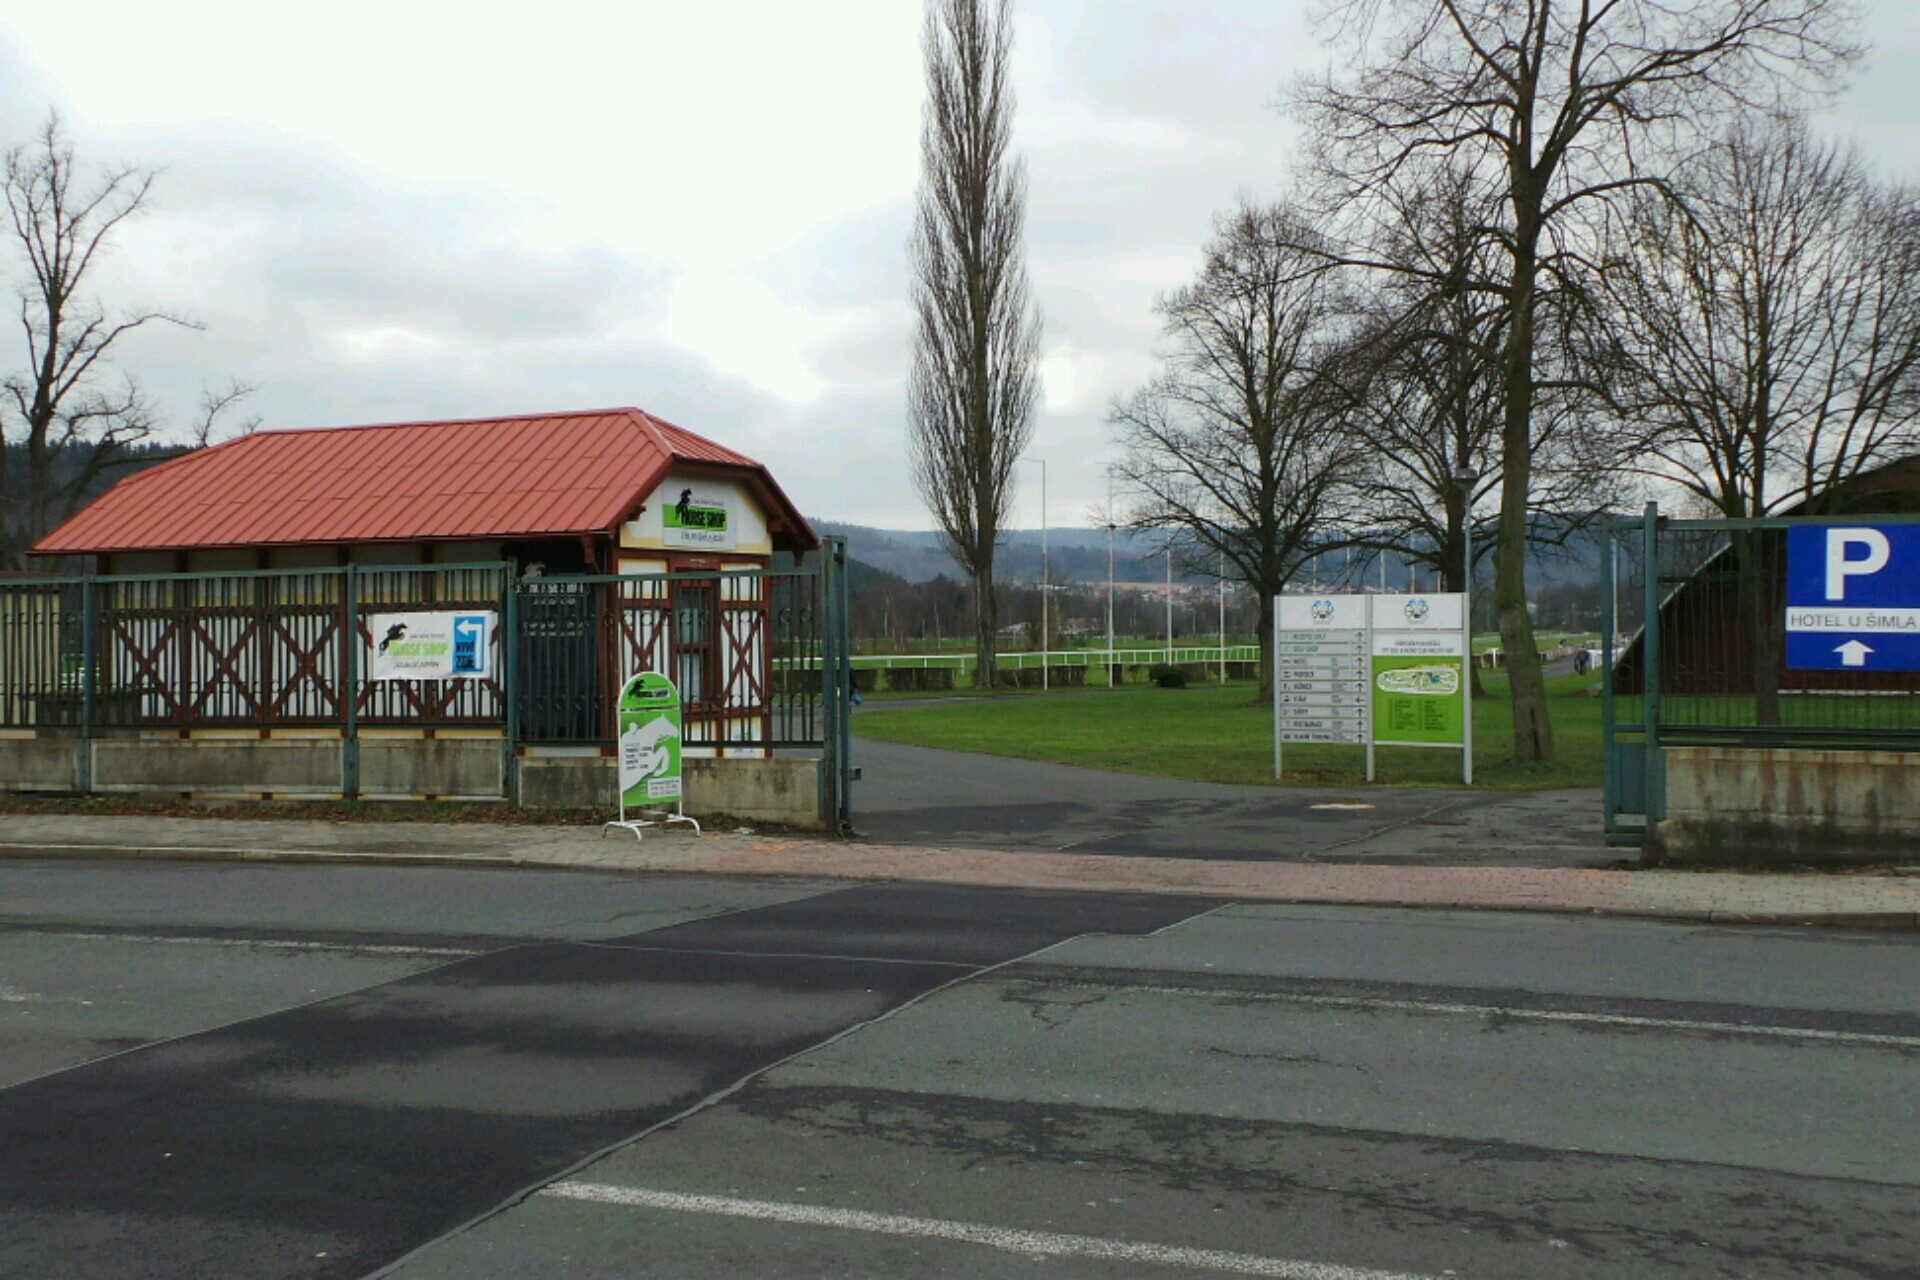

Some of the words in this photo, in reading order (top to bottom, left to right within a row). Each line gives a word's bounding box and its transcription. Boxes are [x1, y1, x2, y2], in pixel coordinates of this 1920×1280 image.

[706, 510, 726, 528] SHOP
[1825, 527, 1890, 601] P
[1791, 614, 1843, 628] HOTEL
[1848, 615, 1860, 628] U
[1866, 611, 1917, 629] ŠIMLA
